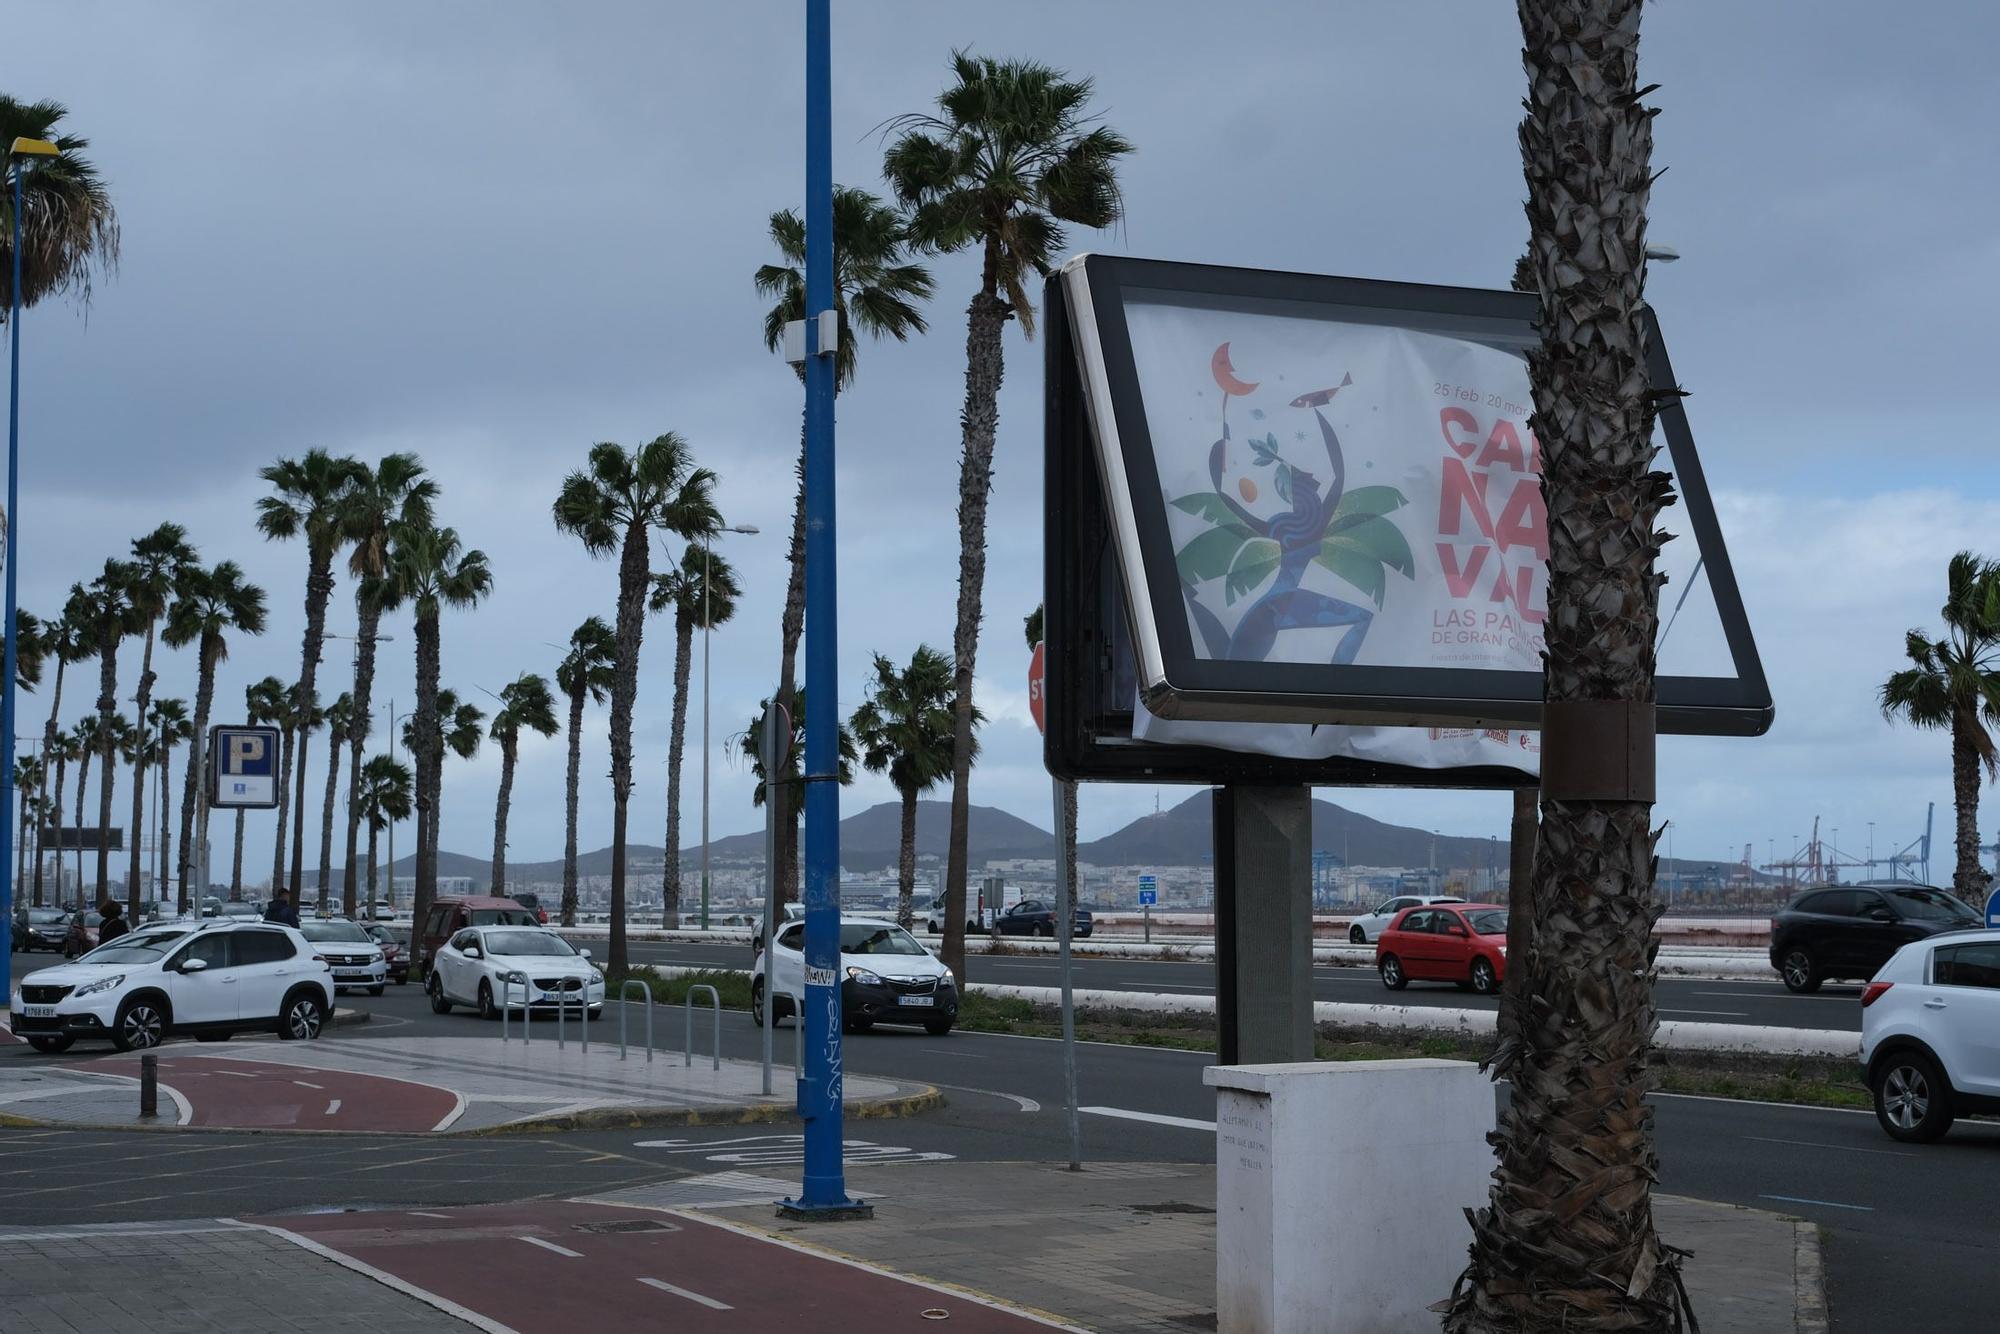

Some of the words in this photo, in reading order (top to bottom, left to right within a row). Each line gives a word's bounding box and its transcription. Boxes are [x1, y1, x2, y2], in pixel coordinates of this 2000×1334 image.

[1433, 382, 1449, 397] 25
[1455, 385, 1479, 402] feb
[1487, 393, 1501, 408] 20
[1433, 609, 1476, 628] LAS
[1431, 631, 1452, 645] DE
[1457, 631, 1502, 646] GRAN
[230, 735, 264, 774] P
